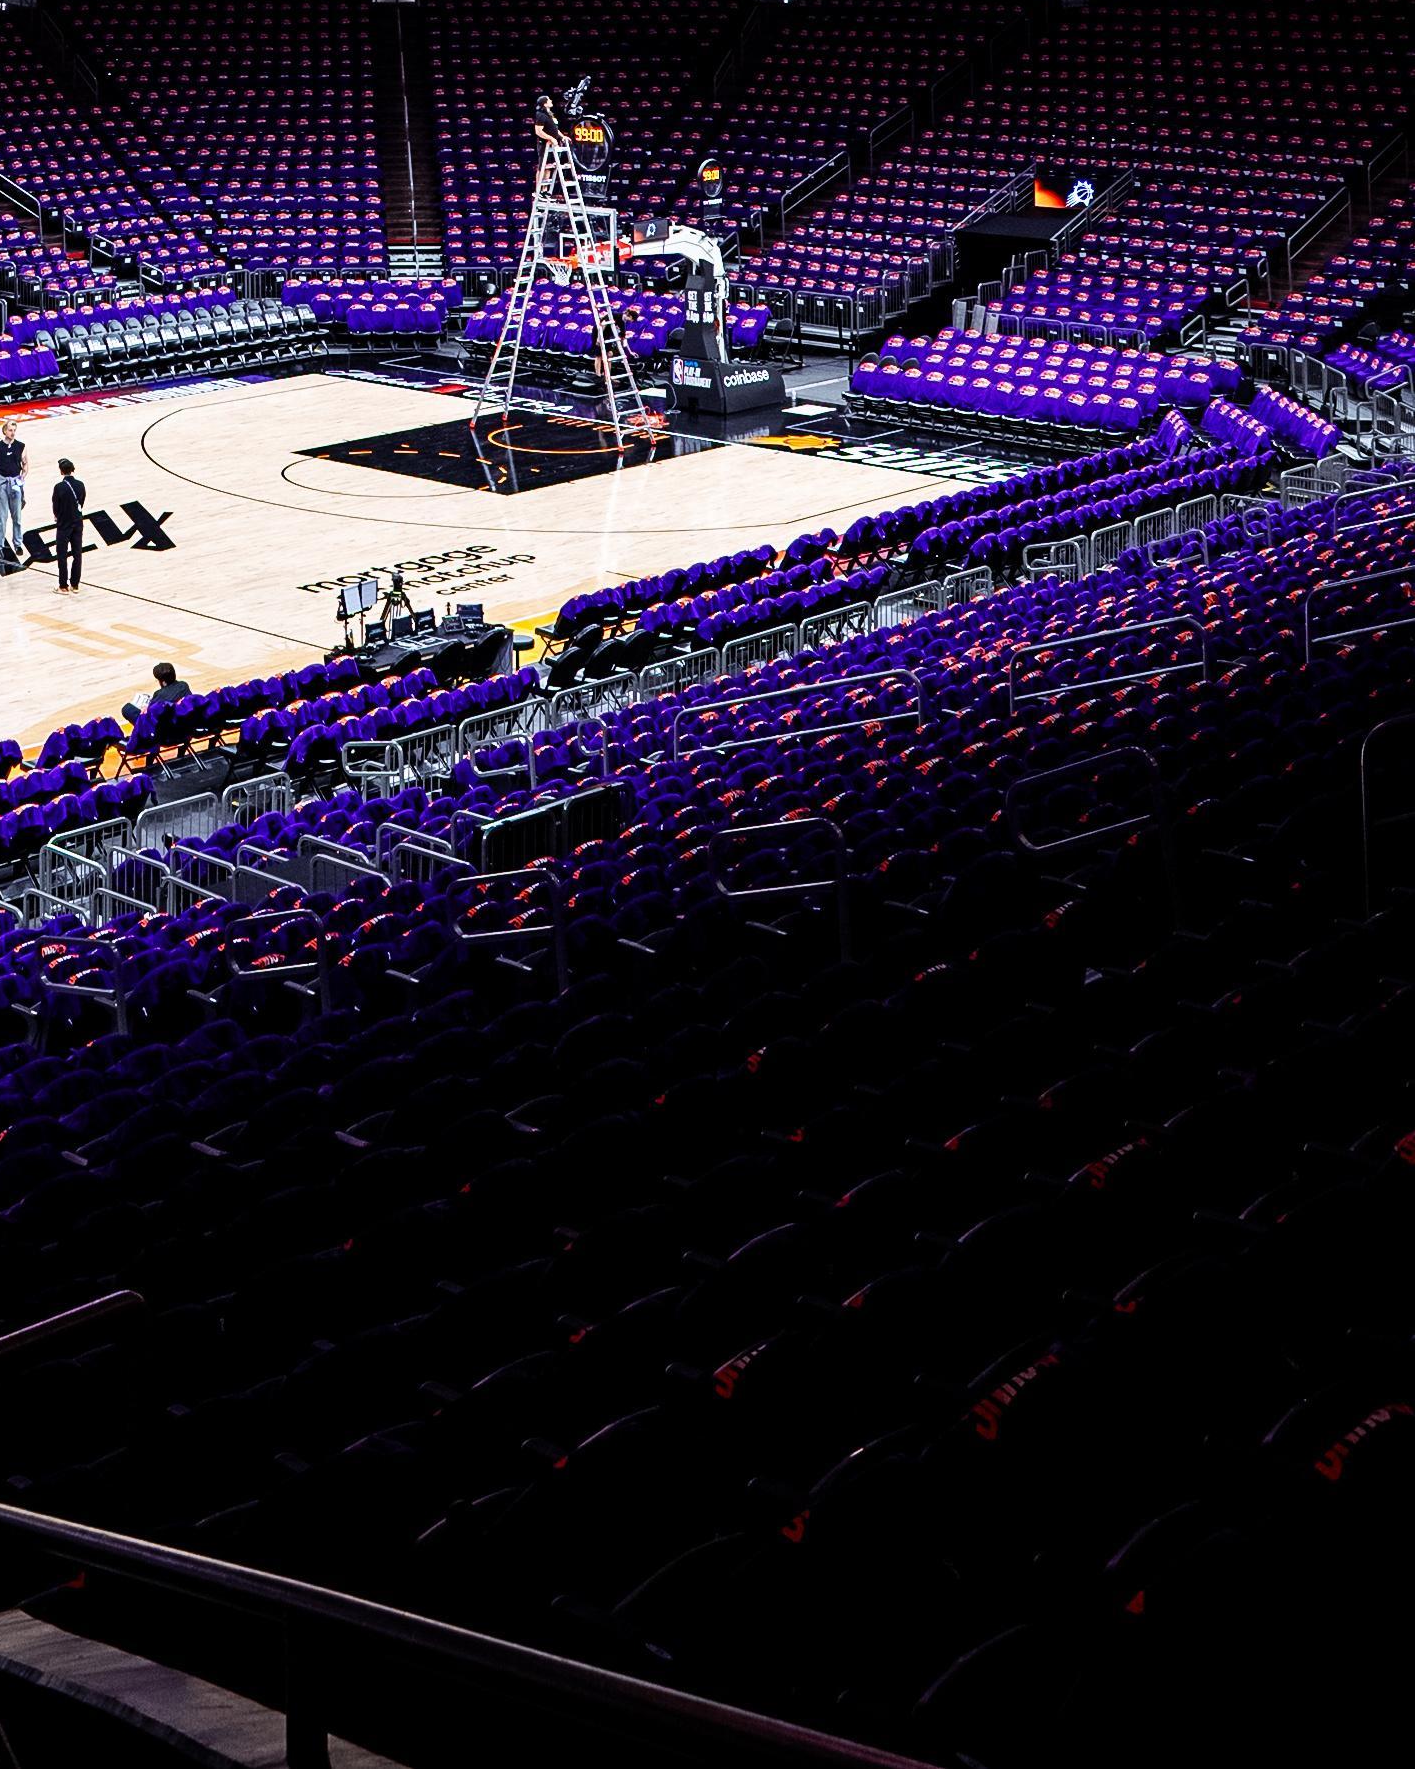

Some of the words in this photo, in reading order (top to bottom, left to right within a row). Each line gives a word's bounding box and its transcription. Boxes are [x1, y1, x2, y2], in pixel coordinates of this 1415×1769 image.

[574, 127, 604, 143] 99:00
[723, 369, 770, 388] coinbase
[296, 545, 497, 594] mortgage
[436, 572, 516, 596] center
